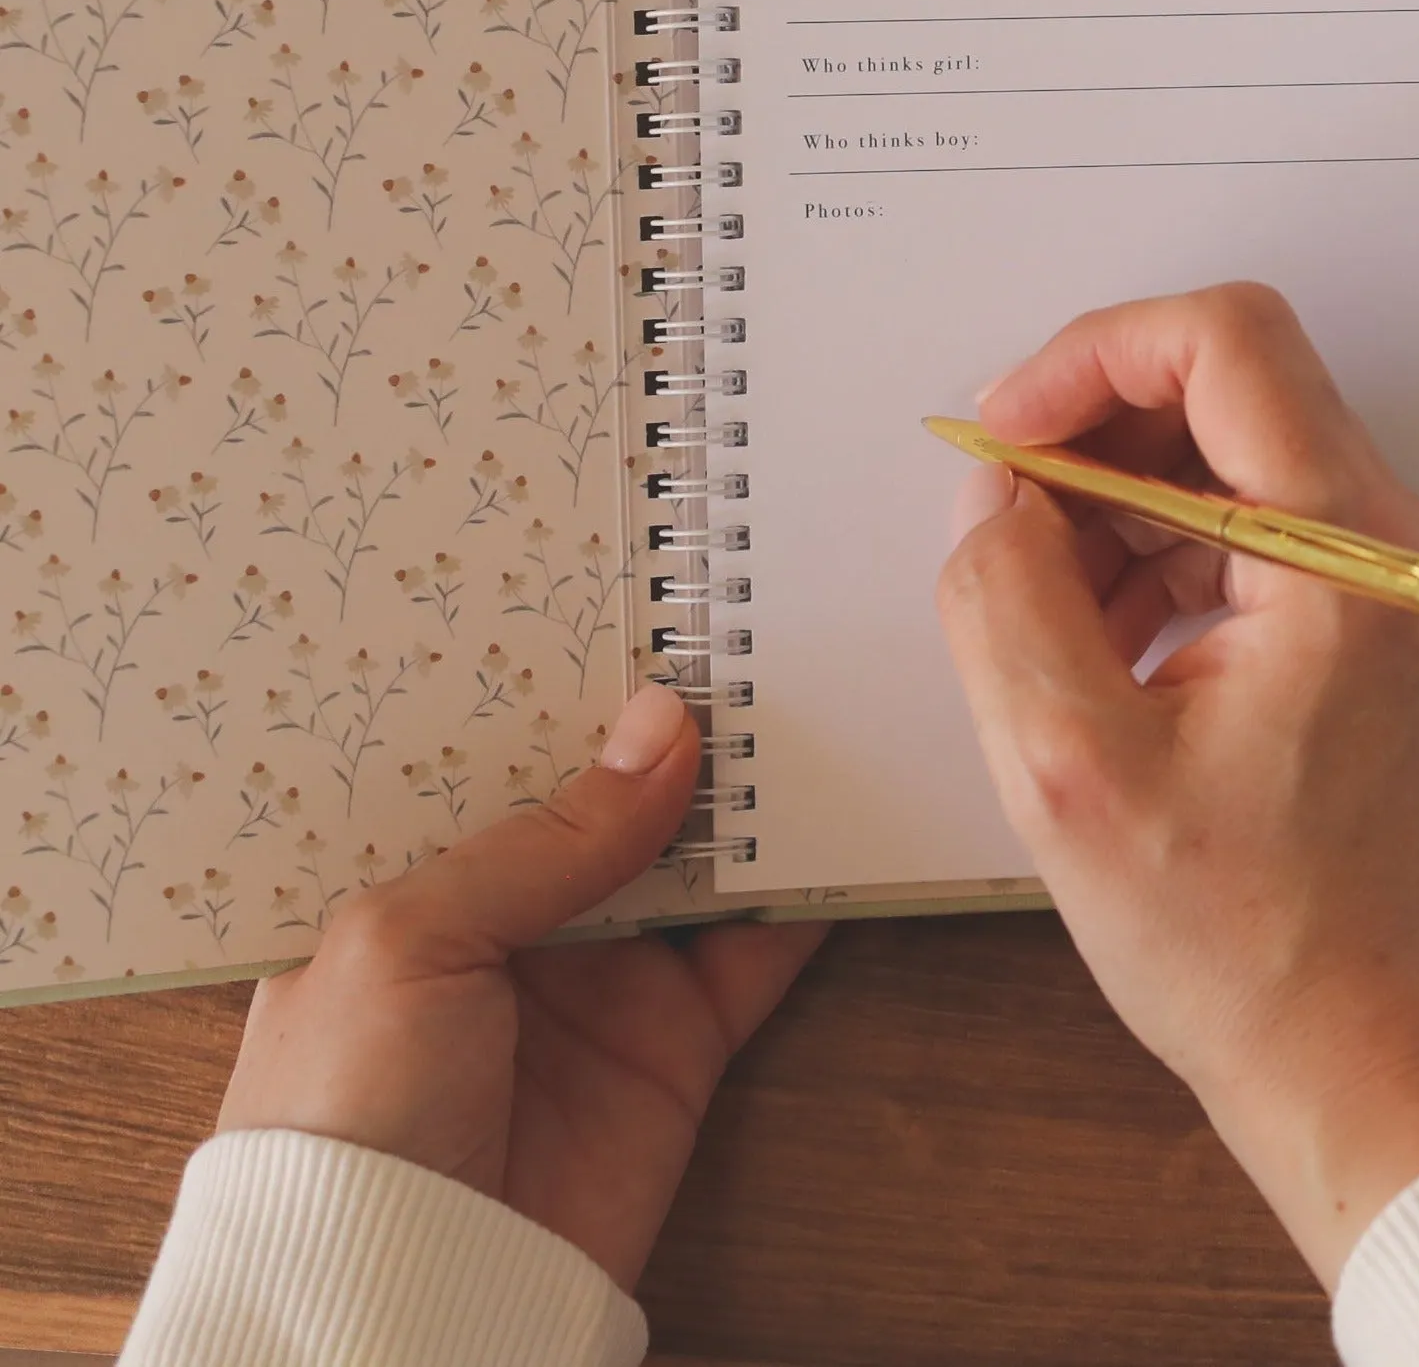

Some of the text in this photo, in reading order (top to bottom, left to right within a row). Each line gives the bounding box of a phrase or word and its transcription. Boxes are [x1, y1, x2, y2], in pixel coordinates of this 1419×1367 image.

[802, 55, 979, 75] Who thinks girl:
[803, 132, 977, 150] Who thinks boy:
[805, 202, 883, 218] Photos:
